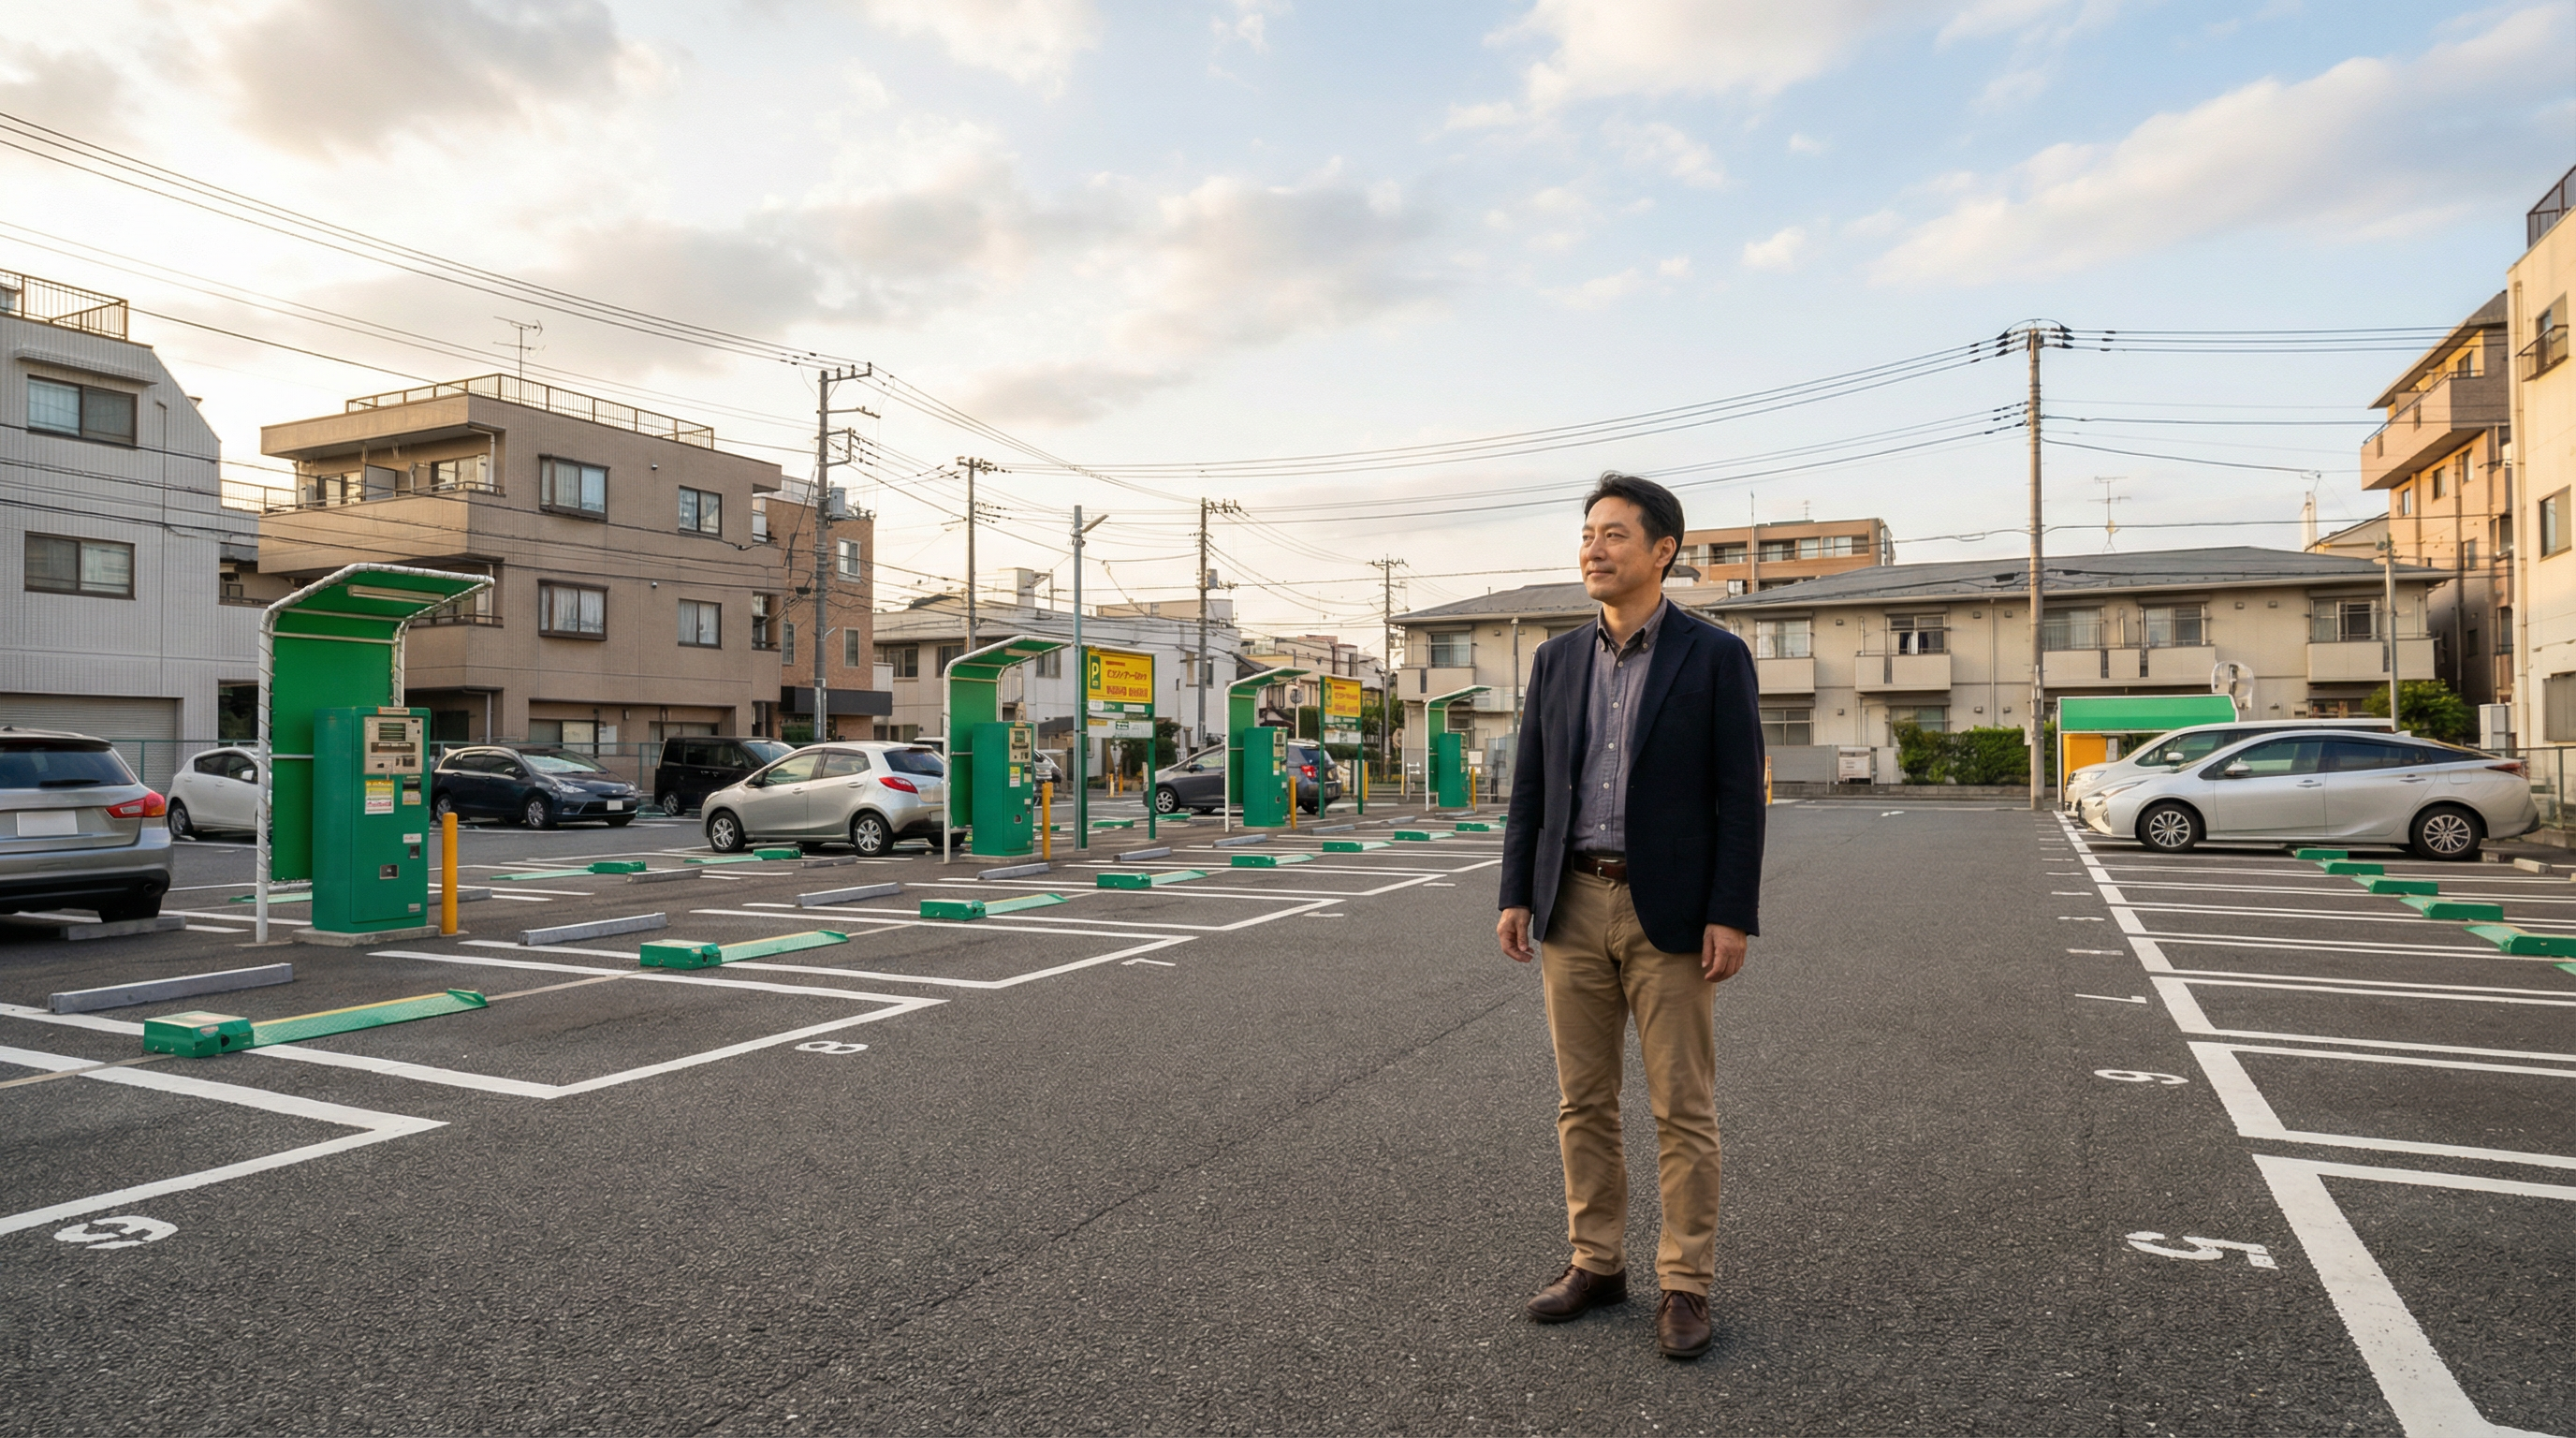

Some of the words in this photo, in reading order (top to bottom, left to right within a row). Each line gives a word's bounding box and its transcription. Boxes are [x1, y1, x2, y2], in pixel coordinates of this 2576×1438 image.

[1091, 662, 1100, 680] P
[795, 1040, 869, 1055] 8
[2125, 1230, 2279, 1270] 5
